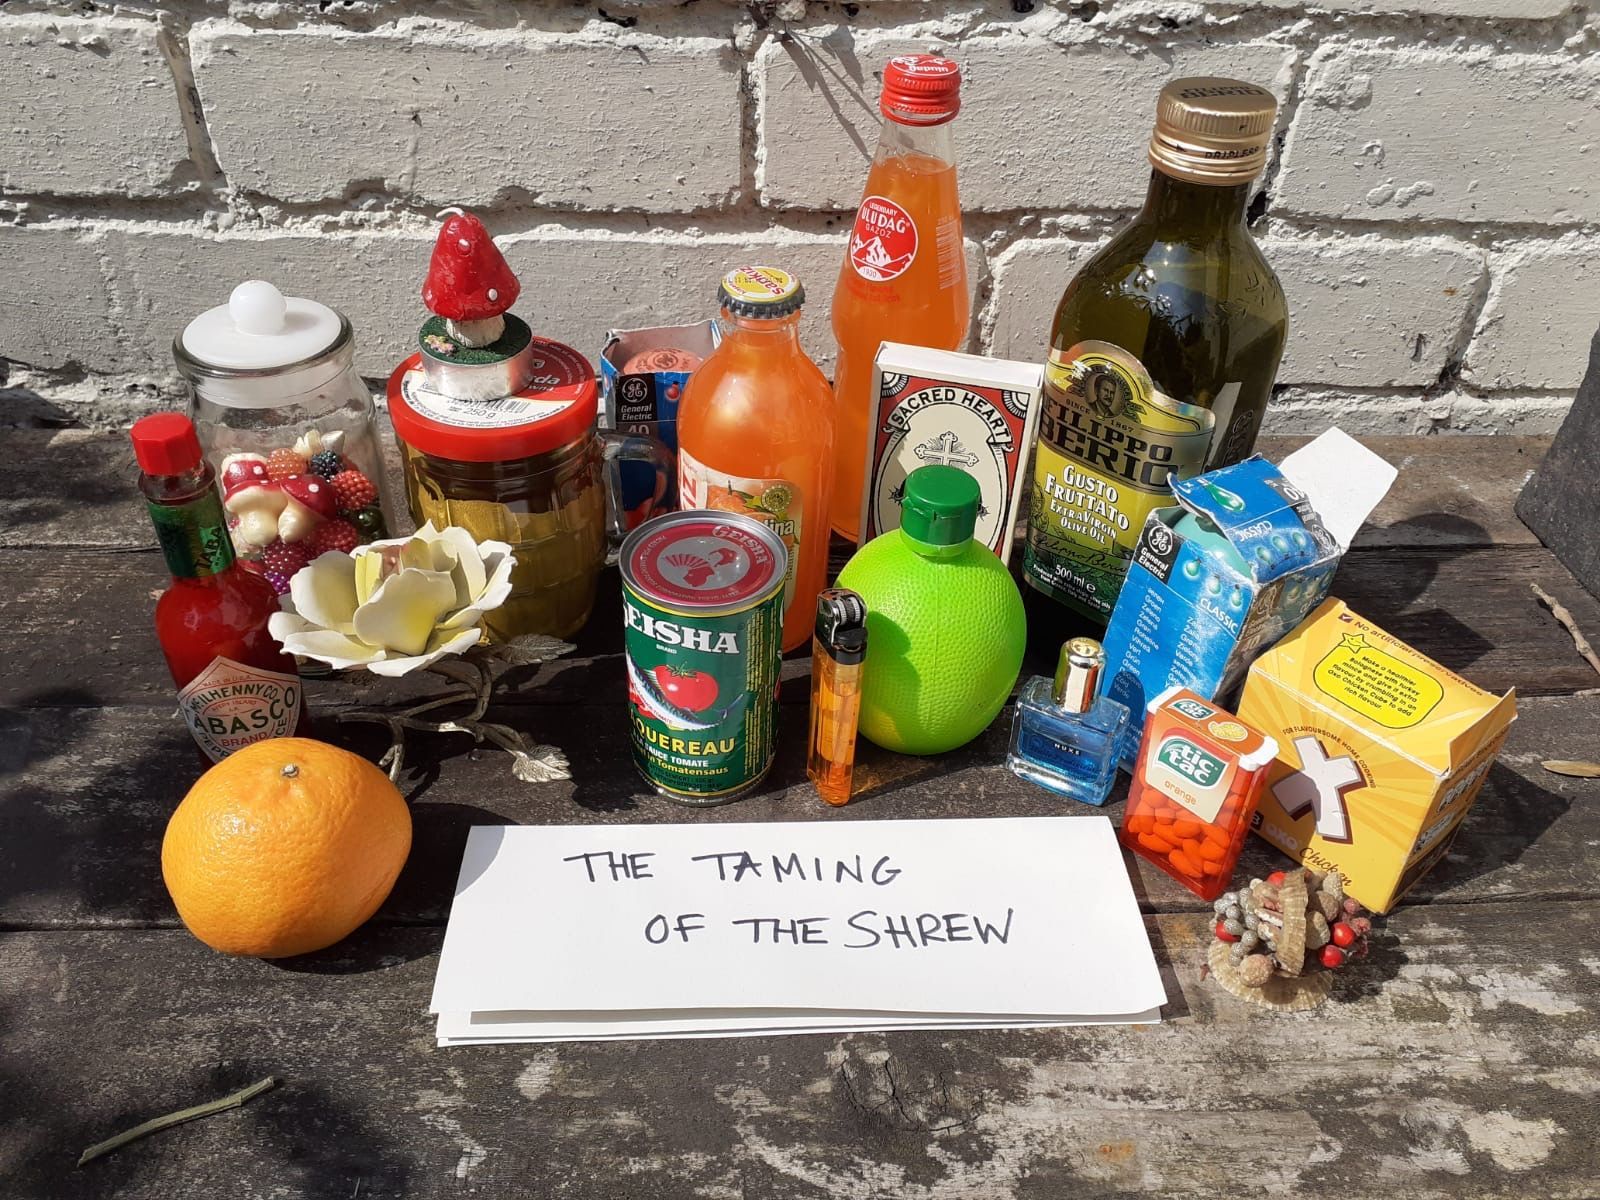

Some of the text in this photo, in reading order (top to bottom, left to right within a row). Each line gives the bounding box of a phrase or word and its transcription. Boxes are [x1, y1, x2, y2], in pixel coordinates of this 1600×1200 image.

[865, 223, 892, 239] GAZOZ
[463, 406, 486, 418] 250
[621, 403, 652, 413] General
[622, 412, 652, 421] Electric
[890, 387, 1011, 441] SACRED HEART
[1063, 465, 1119, 503] GUSTO
[1044, 473, 1130, 531] FRUTTATO
[1138, 556, 1165, 580] Electric
[1140, 546, 1170, 571] General
[1054, 564, 1073, 581] 500
[1073, 574, 1085, 588] ml
[1199, 597, 1239, 636] CLASSIC
[1354, 621, 1370, 632] No
[1361, 655, 1380, 668] Make
[1332, 664, 1356, 678] flavour
[1355, 676, 1365, 684] by
[1365, 682, 1399, 702] crumbling
[1407, 703, 1417, 711] an
[1342, 661, 1362, 674] mince
[1363, 671, 1377, 682] and
[1376, 680, 1392, 690] give
[1399, 690, 1418, 703] extra
[1343, 686, 1358, 696] rich
[1384, 675, 1398, 685] with
[1342, 677, 1369, 694] Chicken
[1369, 691, 1388, 704] Cube
[1389, 701, 1397, 709] to
[1397, 706, 1413, 717] add
[186, 686, 296, 735] ABASCO
[220, 731, 268, 748] BRAND
[656, 760, 729, 776] Tomatensaus
[670, 755, 709, 768] TOMATE
[1168, 752, 1211, 785] tac
[1178, 743, 1215, 774] tic
[1282, 726, 1377, 789] FOR FLAVOURSOME HOME COOKING
[1164, 779, 1198, 806] orange
[563, 851, 902, 886] THE TAMING
[644, 908, 1015, 950] OF THE SHREW
